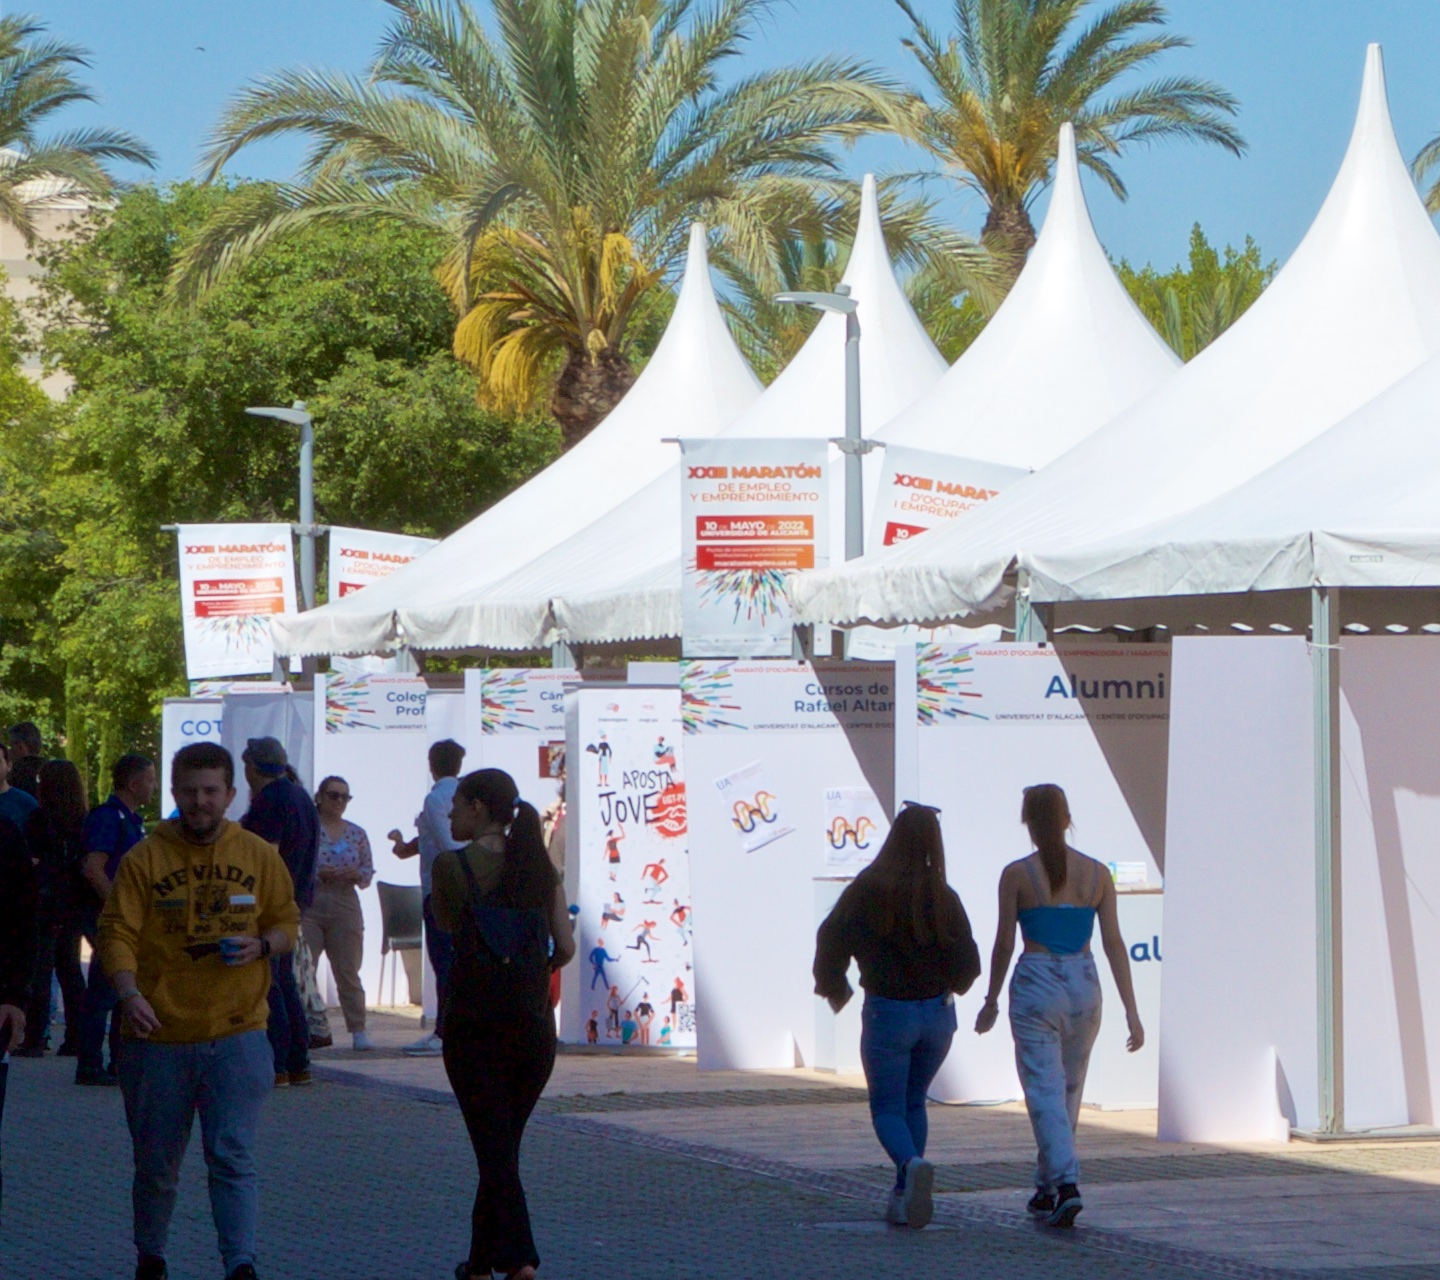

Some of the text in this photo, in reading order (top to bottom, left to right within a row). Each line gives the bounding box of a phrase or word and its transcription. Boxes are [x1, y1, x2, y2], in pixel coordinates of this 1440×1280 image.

[687, 463, 822, 479] XXIII MARATÓN
[718, 483, 791, 492] DE EMPLEO
[701, 492, 819, 502] EMPRENDIMIENTO
[805, 681, 889, 696] Cursos de
[1044, 672, 1165, 699] Alumni
[794, 698, 848, 713] Rafael
[622, 769, 677, 792] APOSTA
[598, 790, 661, 827] JOVE
[153, 864, 256, 897] NEVADA
